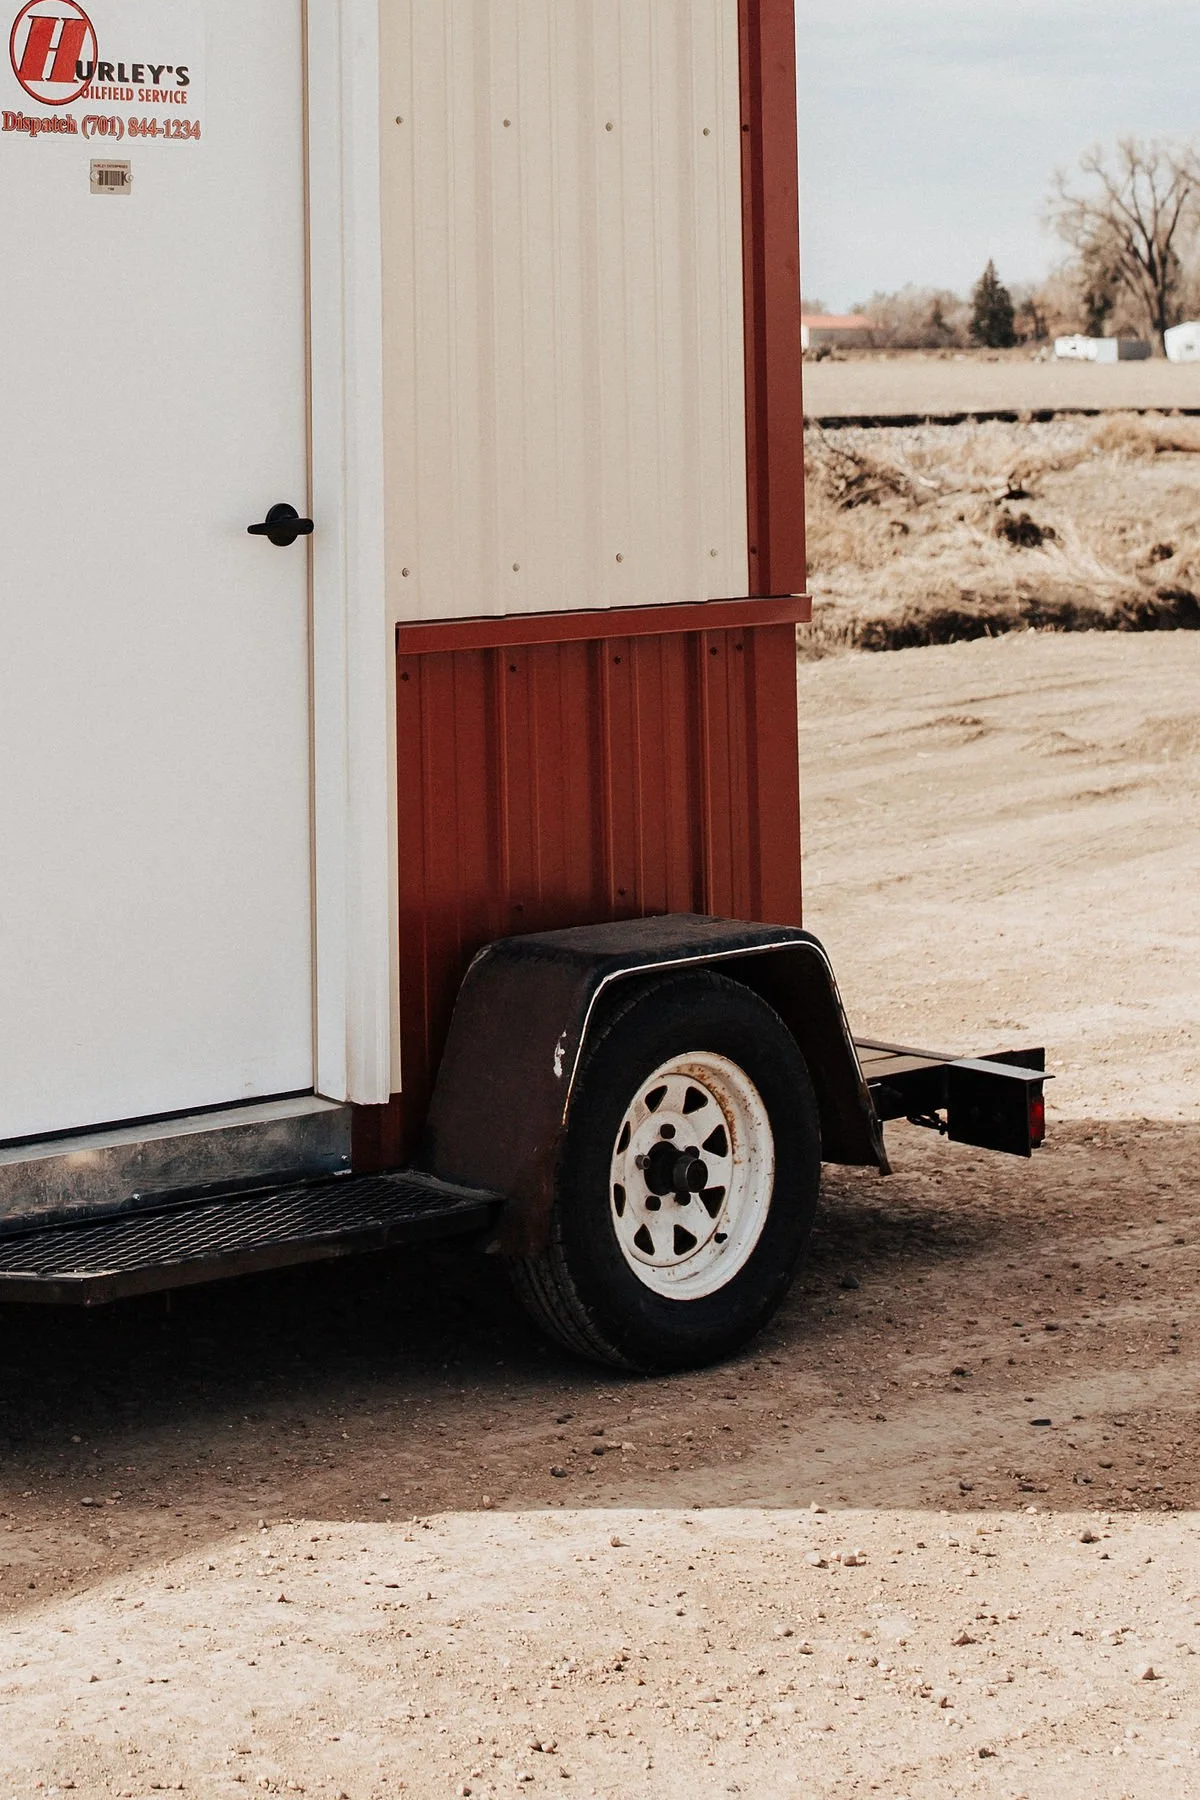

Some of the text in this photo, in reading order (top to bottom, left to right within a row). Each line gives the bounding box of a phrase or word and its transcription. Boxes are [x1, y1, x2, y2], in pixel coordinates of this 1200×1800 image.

[81, 86, 187, 104] OILFIELD SERVICE
[2, 111, 201, 141] Dispatch (701) 844-1234
